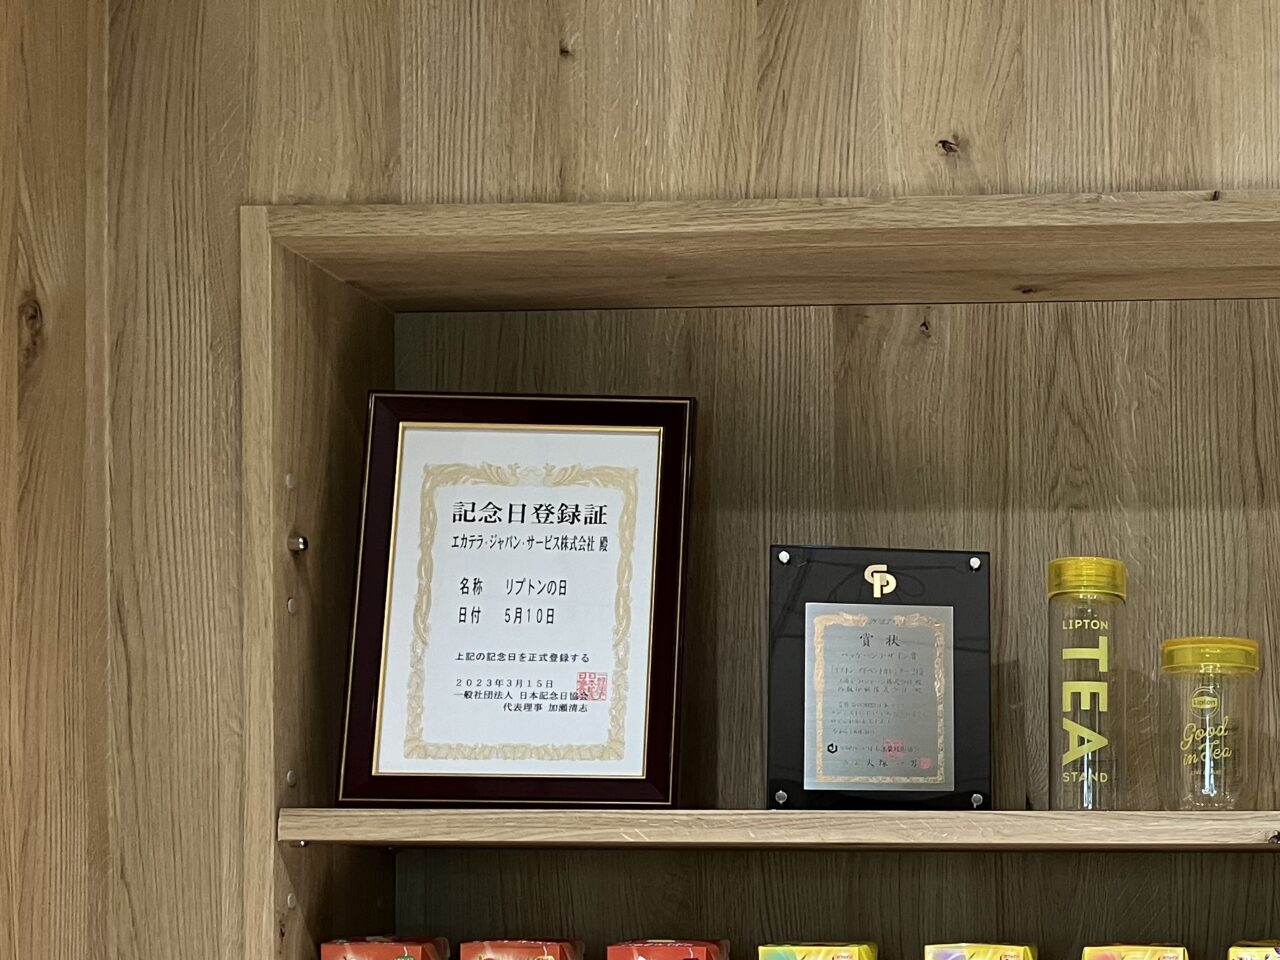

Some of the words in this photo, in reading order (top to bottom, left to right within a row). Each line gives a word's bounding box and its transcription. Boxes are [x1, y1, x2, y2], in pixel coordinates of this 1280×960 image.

[452, 501, 608, 526] 記念日登録証
[599, 536, 608, 552] 殿
[459, 577, 483, 596] 名称
[505, 578, 567, 596] リプトンの日
[458, 606, 481, 624] 日付
[504, 608, 555, 624] 5月10日
[1062, 619, 1108, 630] LIPTON
[455, 652, 590, 663] 上記の記念日を正式登録する
[456, 678, 554, 688] 2023年3月15日
[453, 690, 513, 700] 一般社団法人
[519, 691, 588, 701] 日本記念日協会
[1062, 635, 1108, 767] TEA
[503, 702, 543, 712] 代表理事
[1180, 715, 1229, 751] Good
[1183, 753, 1198, 765] in
[1063, 771, 1108, 783] STAND
